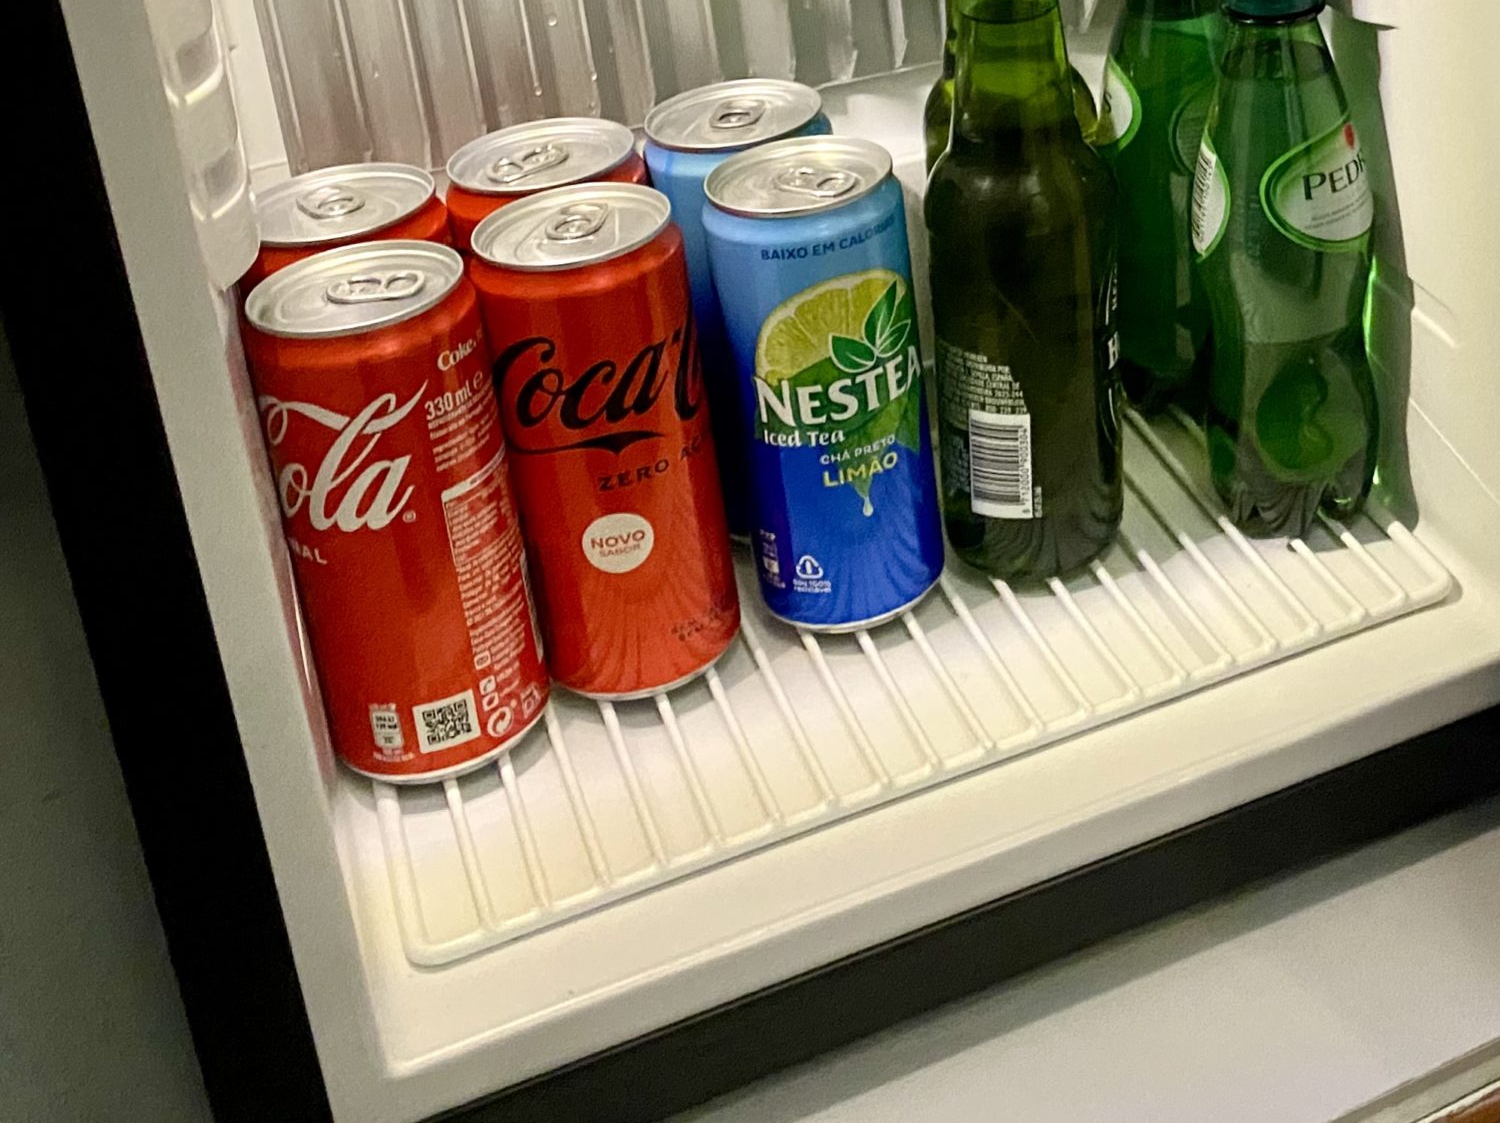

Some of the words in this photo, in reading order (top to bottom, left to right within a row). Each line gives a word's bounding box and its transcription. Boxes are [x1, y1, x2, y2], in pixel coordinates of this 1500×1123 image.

[761, 247, 808, 261] BAIXO
[812, 241, 835, 257] EM
[424, 390, 454, 421] 330
[454, 378, 473, 407] ml
[753, 344, 922, 427] NESTEA
[764, 429, 803, 448] Iced
[806, 429, 846, 448] Tea
[820, 448, 851, 465] CHÁ
[854, 433, 896, 458] PRETO
[258, 378, 429, 534] ola
[822, 451, 898, 488] LIMÃO
[599, 459, 670, 492] ZERO
[590, 528, 646, 550] NOVO
[599, 542, 642, 558] SABOR
